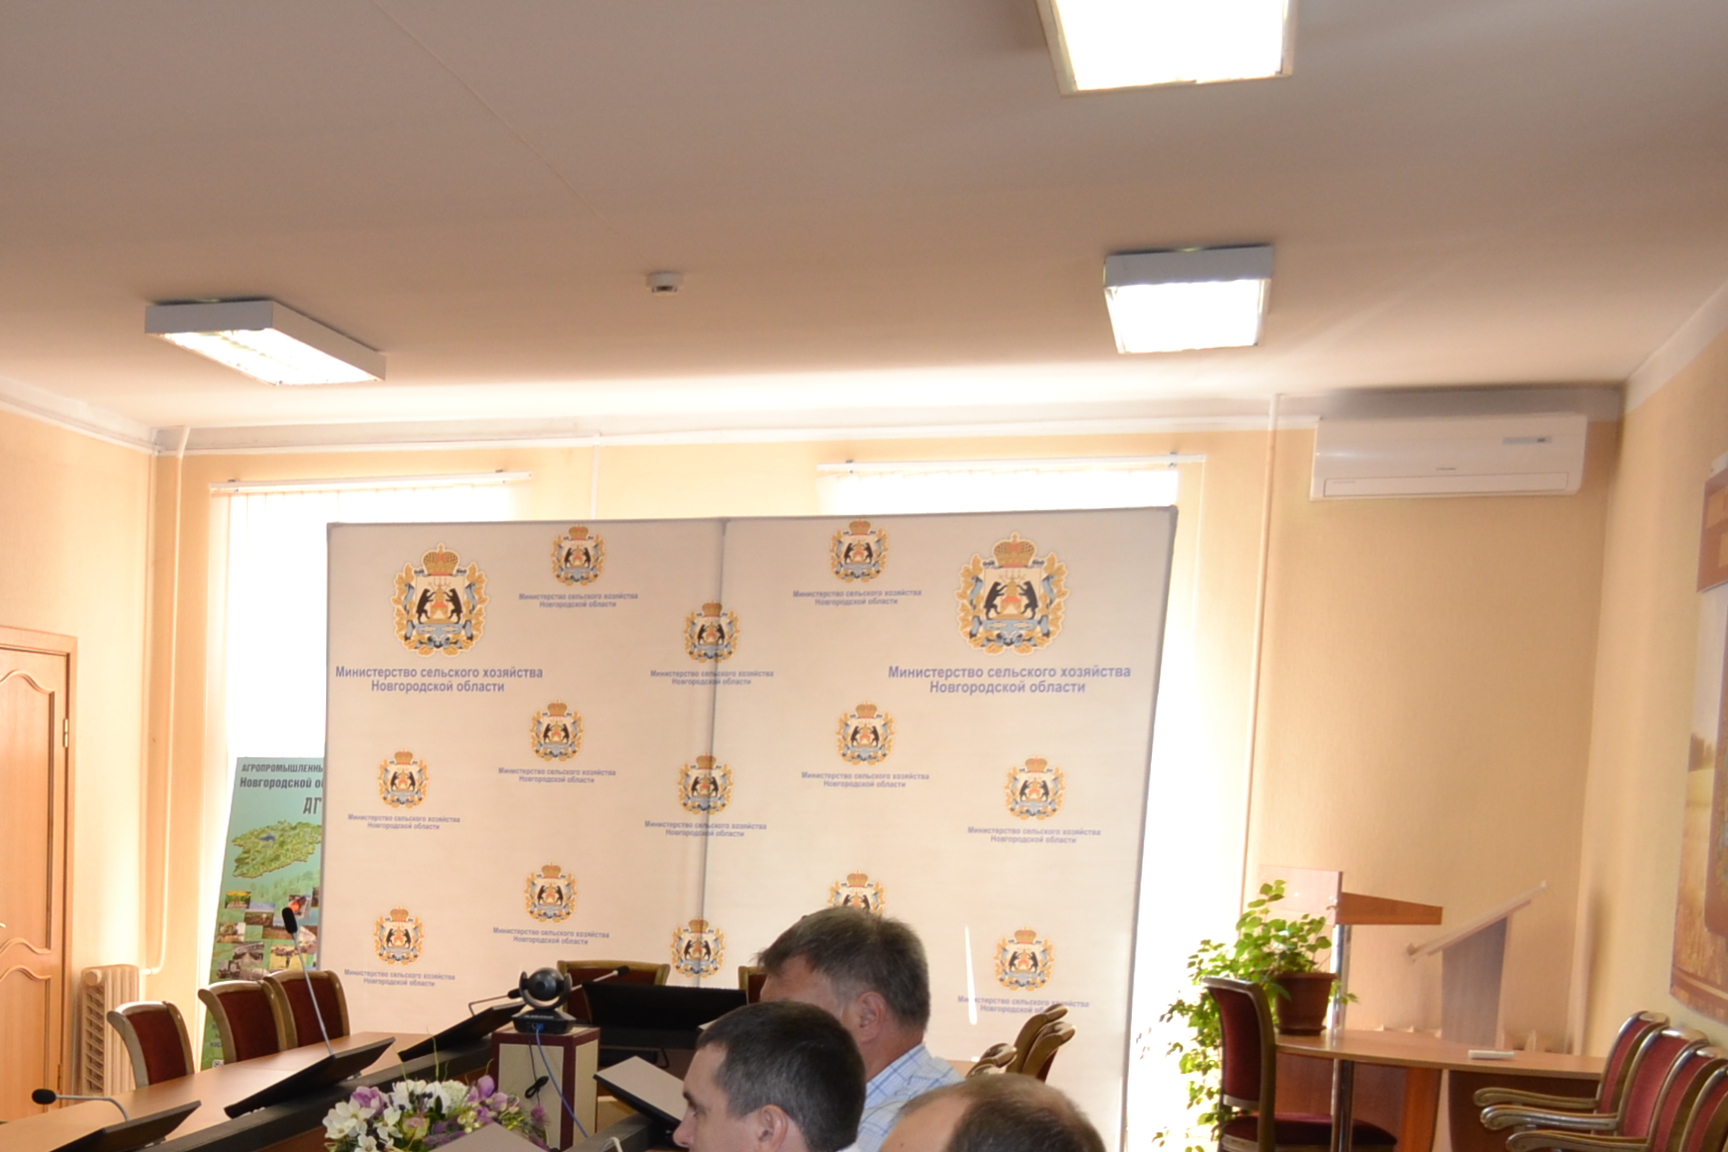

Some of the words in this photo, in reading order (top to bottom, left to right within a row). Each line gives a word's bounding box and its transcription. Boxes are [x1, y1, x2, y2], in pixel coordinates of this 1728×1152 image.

[519, 593, 566, 601] Министерство
[336, 666, 417, 679] Министерство
[420, 668, 479, 678] сельского
[483, 666, 543, 678] хозяйства
[888, 666, 983, 681] Министерство
[987, 667, 1056, 678] сельского
[1060, 665, 1131, 677] хозяйства
[371, 680, 453, 693] Новгородской
[457, 680, 505, 692] области
[930, 680, 1025, 695] Новгородской
[1030, 680, 1085, 693] области
[499, 767, 545, 775] Министерство
[519, 775, 565, 783] Новгородской
[802, 772, 851, 780] Министерство
[893, 772, 929, 780] хозяйства
[240, 777, 312, 789] Новгородской
[824, 780, 874, 788] Новгородской
[968, 827, 1020, 835] Министерство
[991, 835, 1043, 843] Новгородской
[493, 927, 539, 936] Министерство
[513, 935, 560, 944] Новгородской
